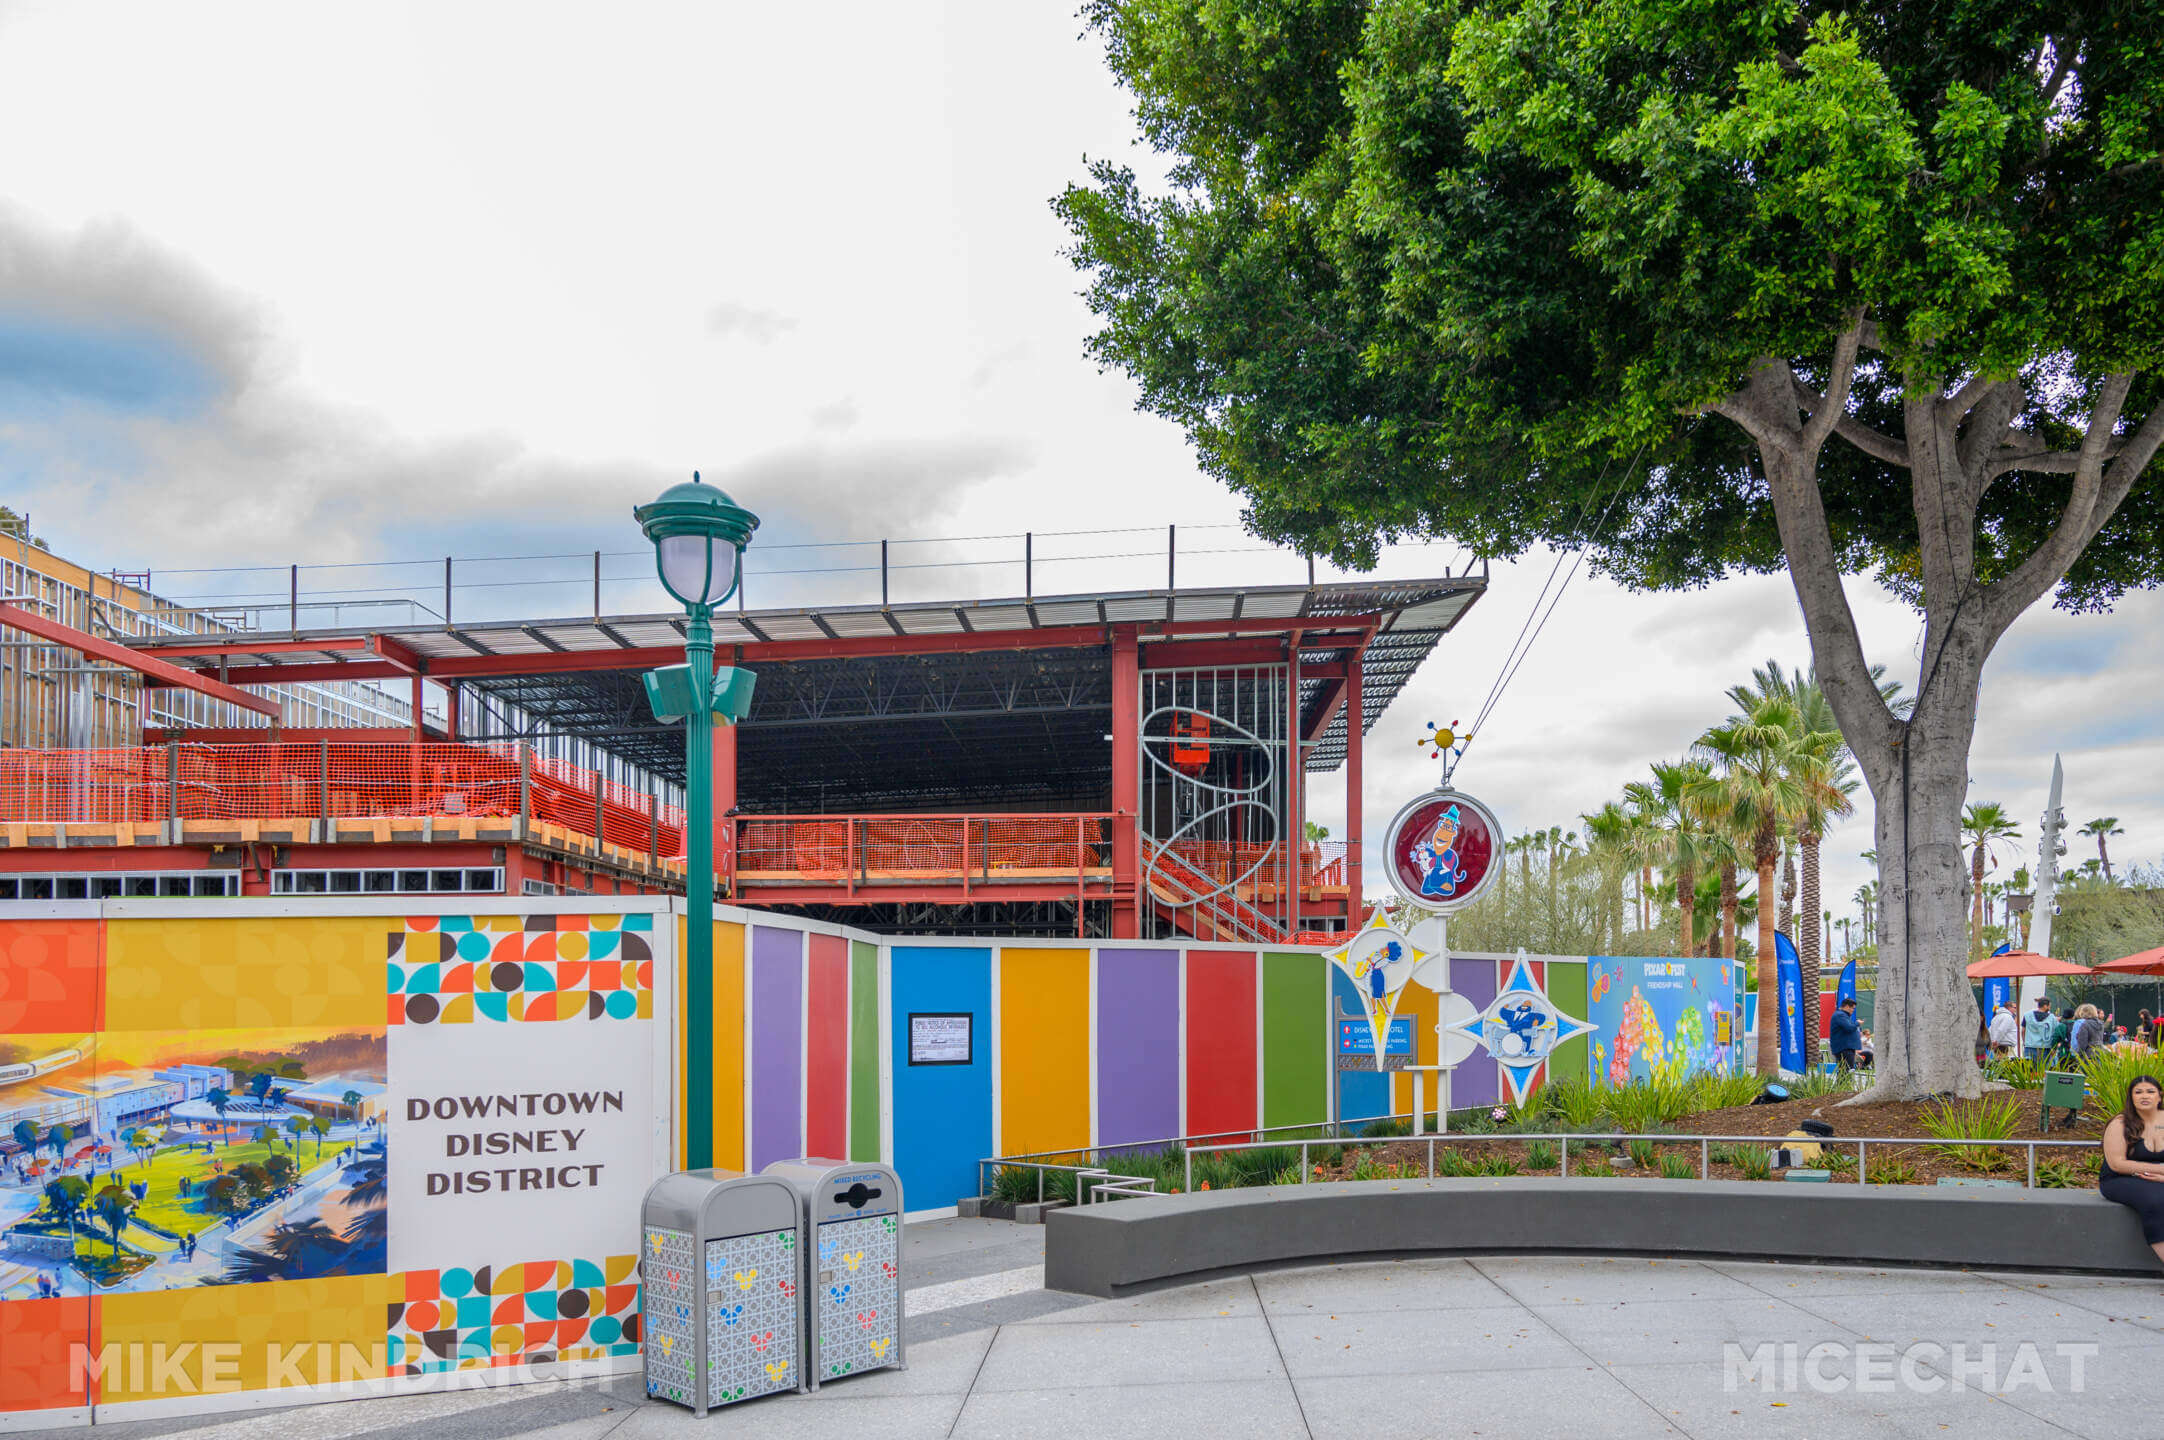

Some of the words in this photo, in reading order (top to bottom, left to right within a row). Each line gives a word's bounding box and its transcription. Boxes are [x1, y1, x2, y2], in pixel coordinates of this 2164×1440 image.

[1644, 963, 1666, 976] PIXAR
[1785, 980, 1796, 1007] FEST
[407, 1090, 624, 1121] DOWNTOWN
[446, 1128, 586, 1158] DISNEY
[426, 1163, 605, 1196] DISTRICT
